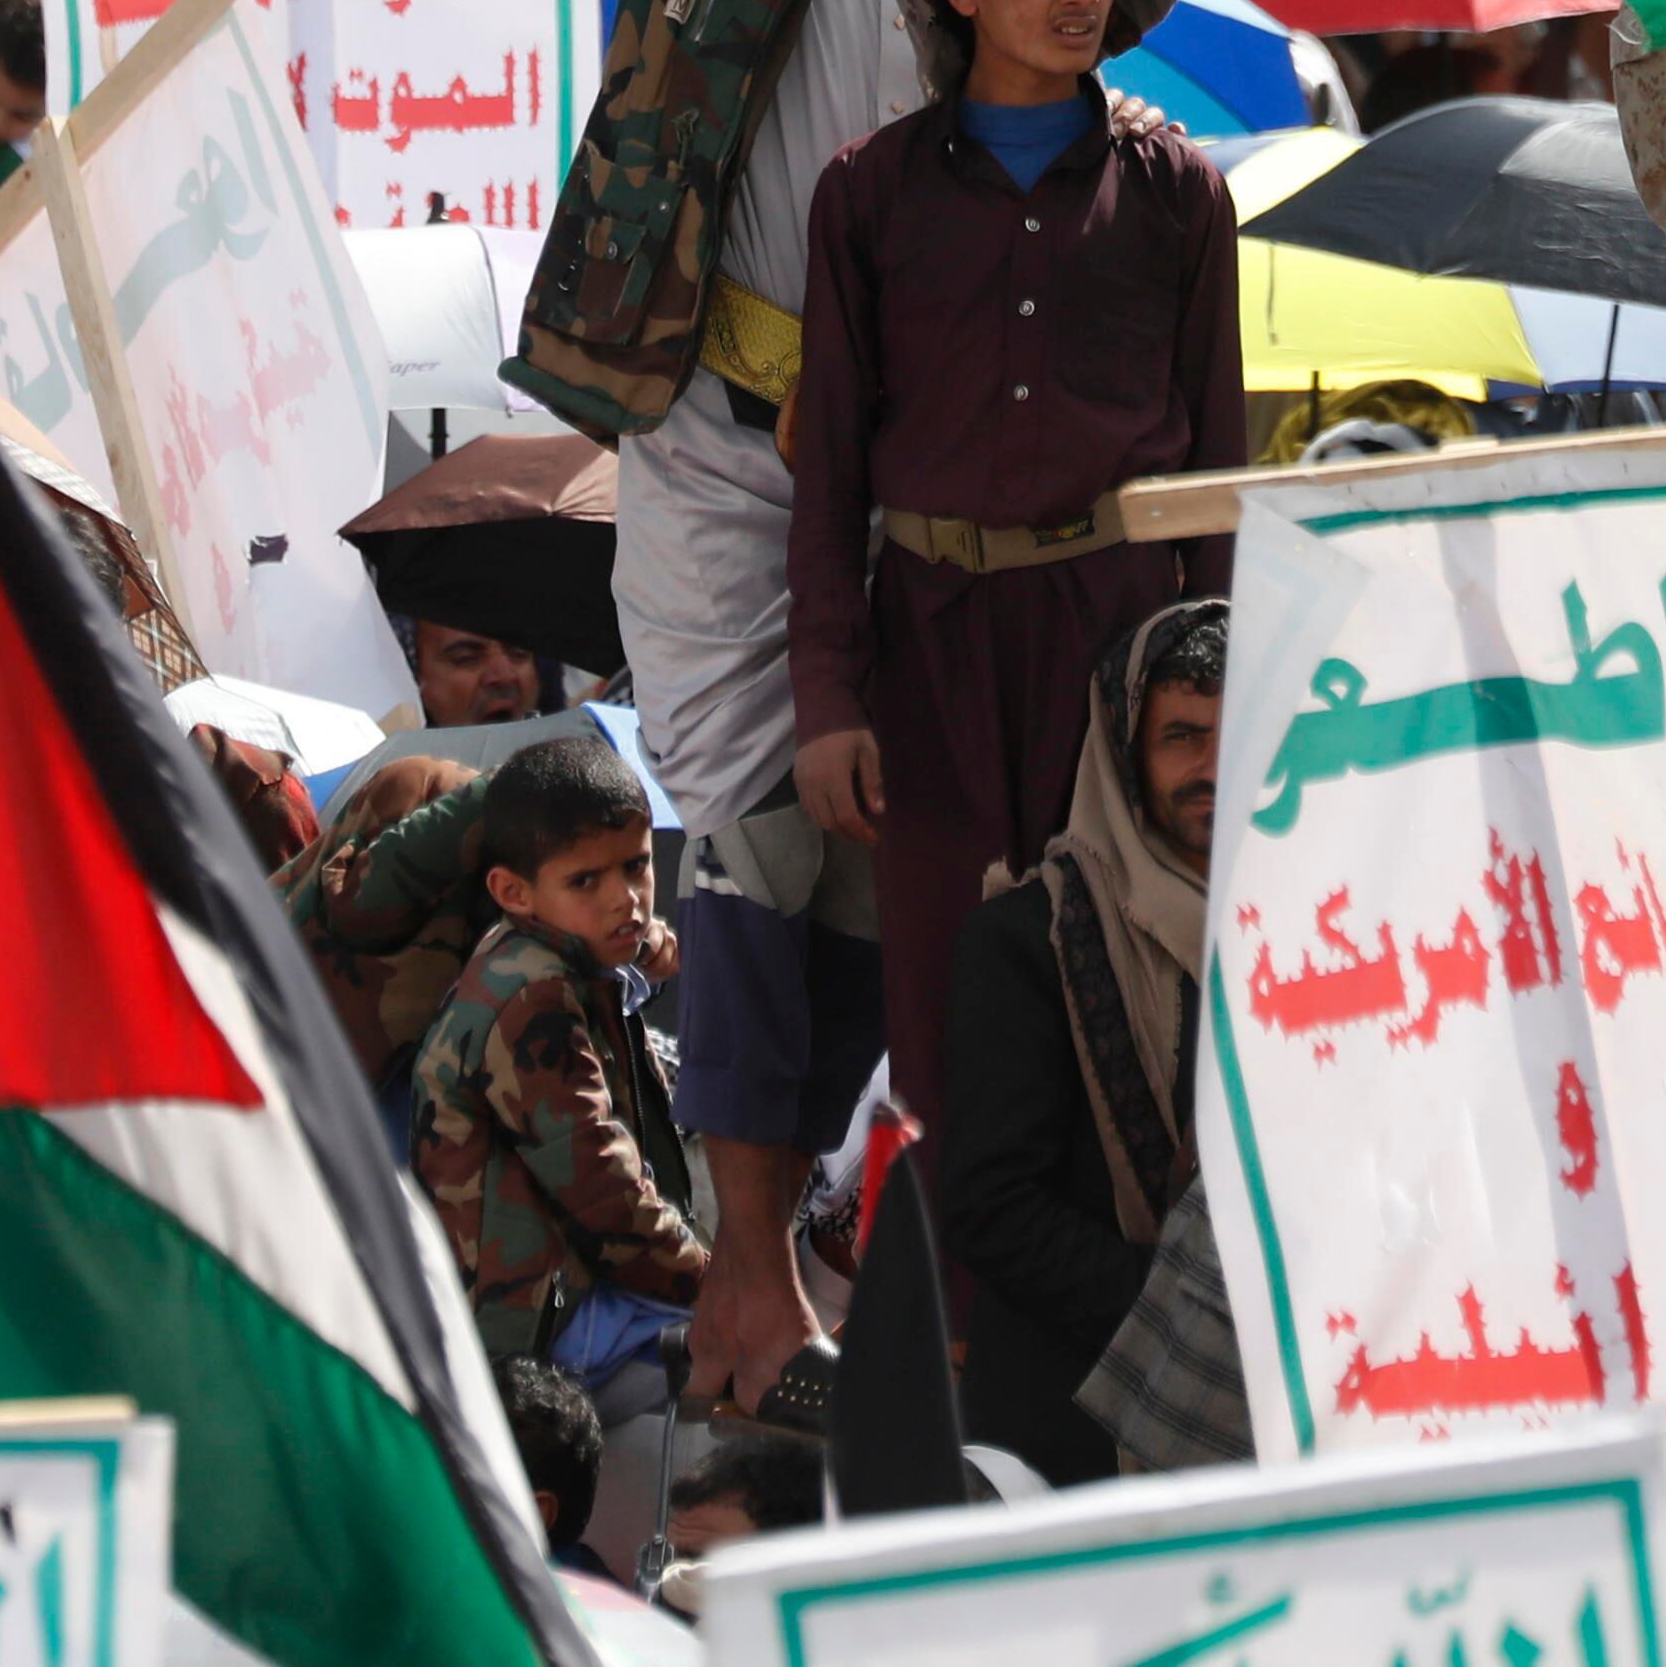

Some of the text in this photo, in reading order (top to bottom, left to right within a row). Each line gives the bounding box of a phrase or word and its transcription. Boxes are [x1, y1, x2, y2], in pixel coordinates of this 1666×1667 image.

[332, 51, 541, 152] الموت
[388, 358, 442, 377] aper
[1236, 827, 1562, 1067] الأمريكية
[1555, 1061, 1600, 1197] و
